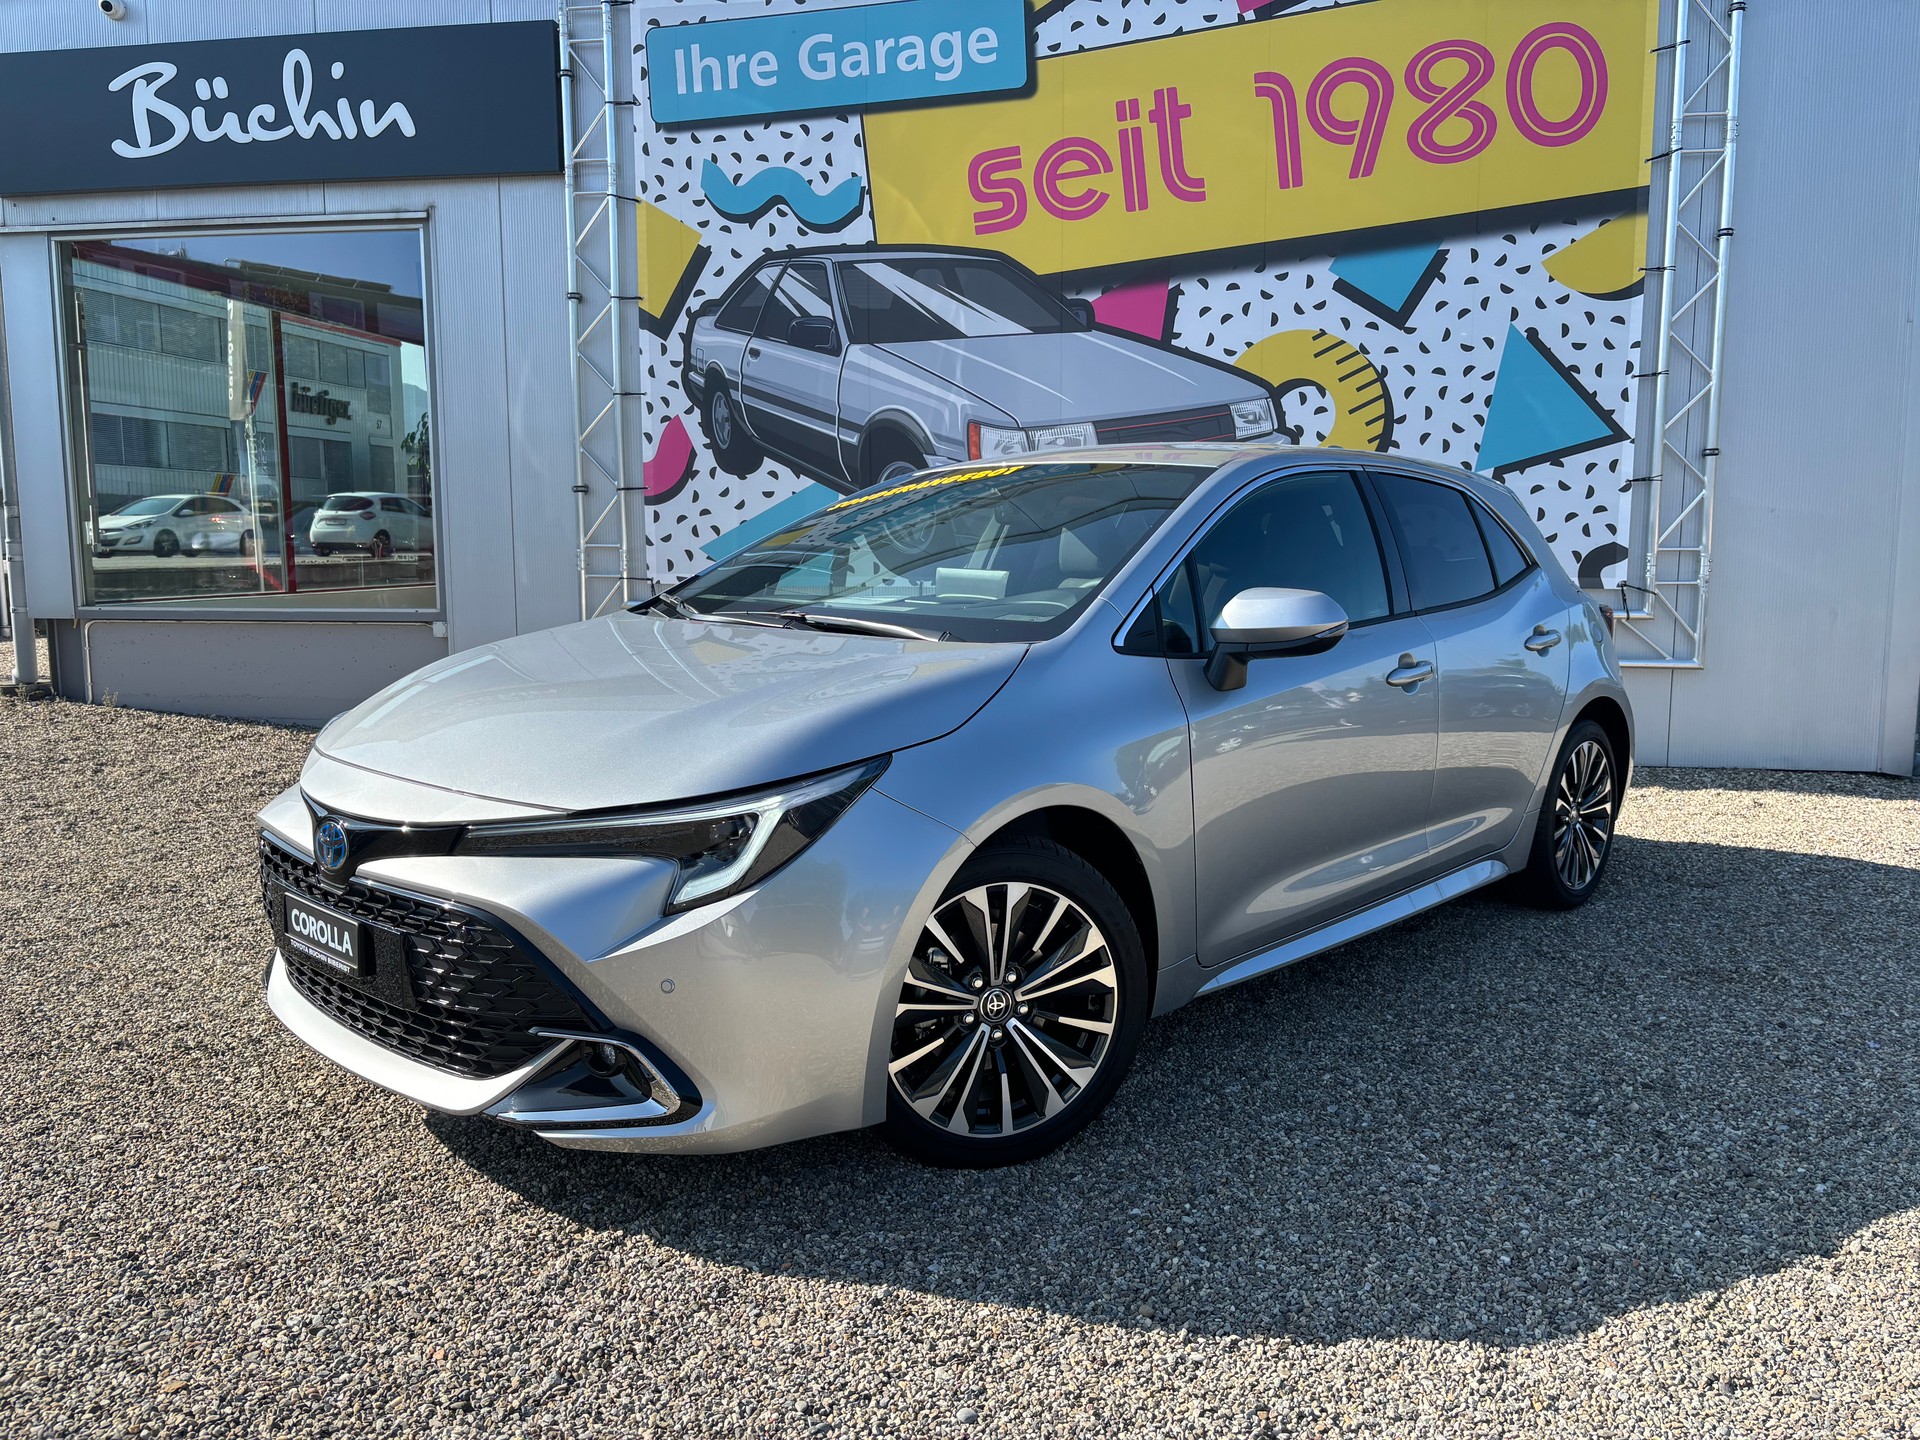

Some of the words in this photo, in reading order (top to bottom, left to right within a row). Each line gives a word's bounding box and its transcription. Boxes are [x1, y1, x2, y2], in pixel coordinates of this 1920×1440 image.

[673, 43, 779, 95] Ihre
[797, 26, 999, 82] Garage
[108, 48, 416, 159] Büchin
[967, 87, 1207, 235] seit
[1254, 22, 1608, 190] 1980
[826, 465, 1025, 512] SONDERANGEBOT
[290, 939, 308, 953] TOYOTA
[291, 908, 353, 957] COROLLA
